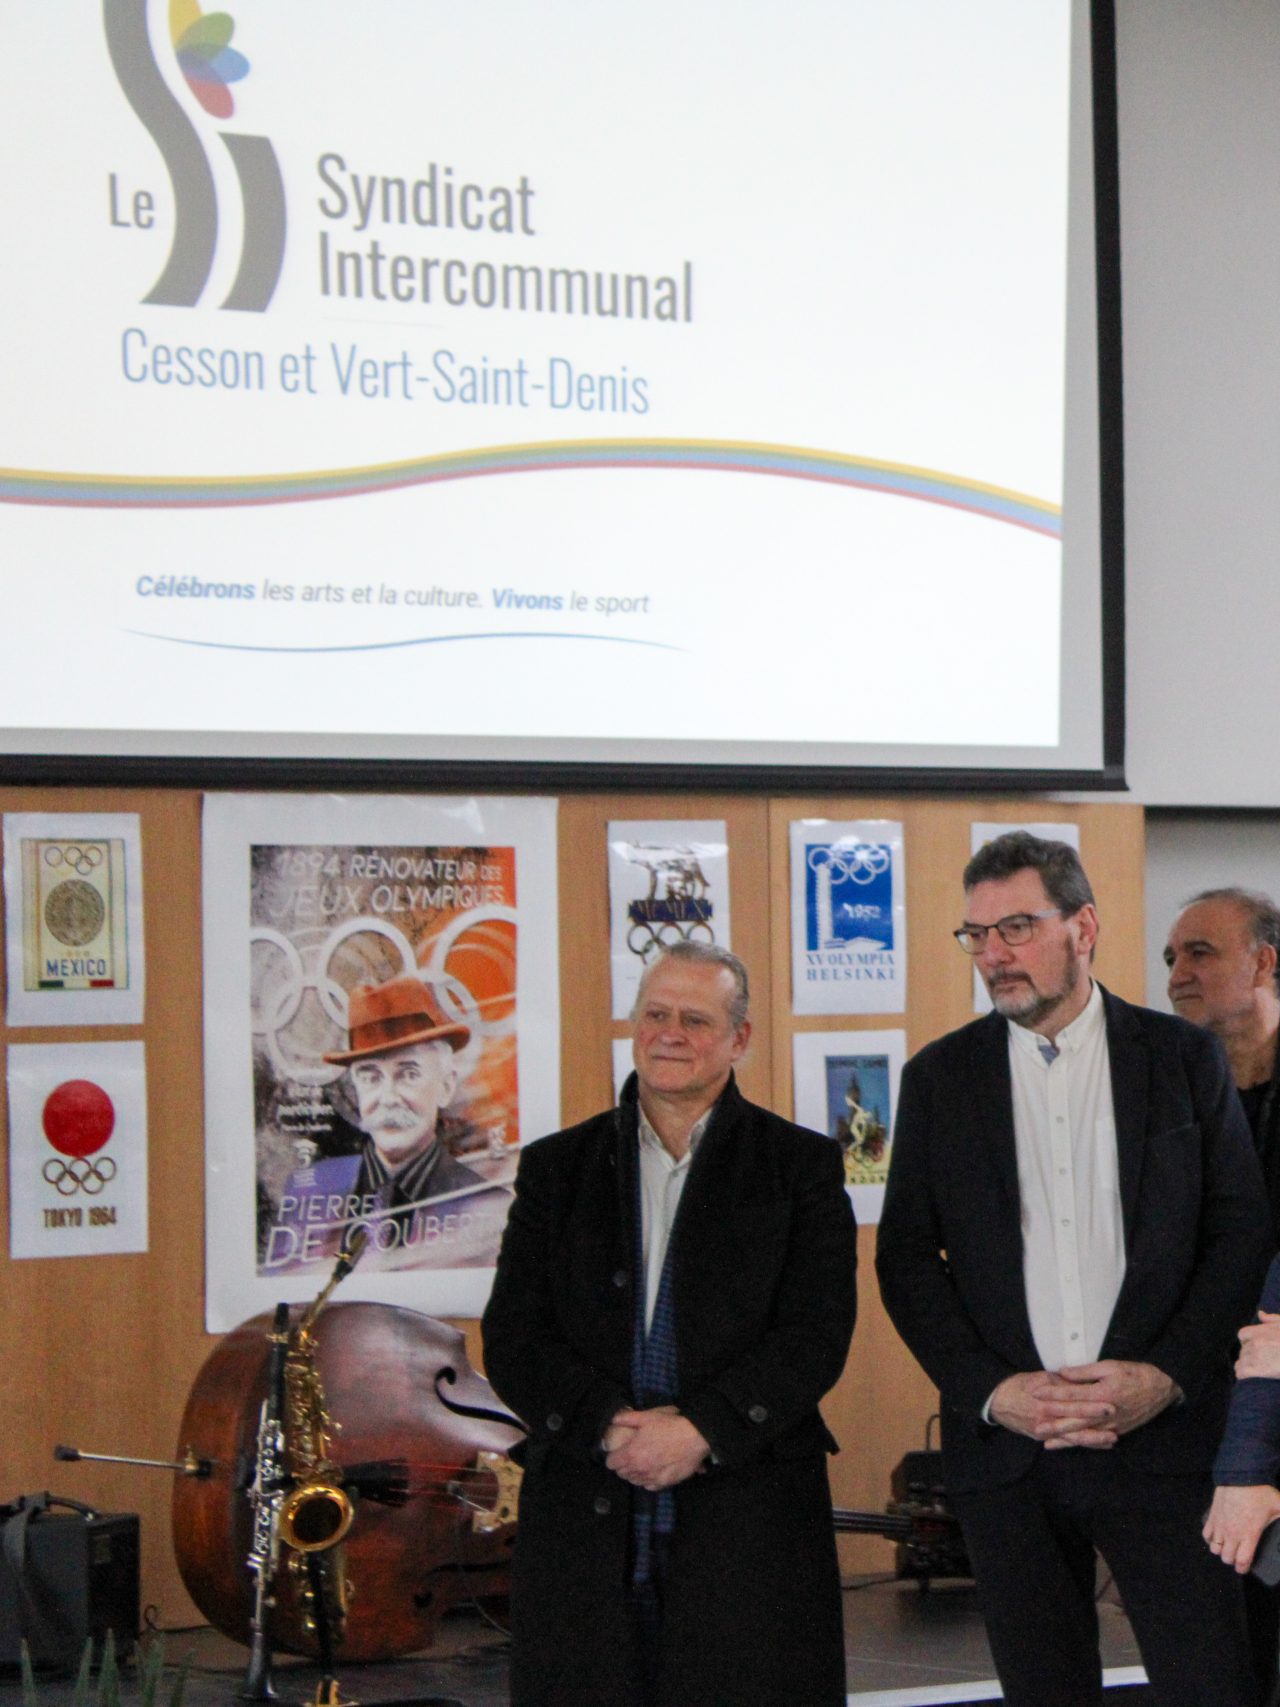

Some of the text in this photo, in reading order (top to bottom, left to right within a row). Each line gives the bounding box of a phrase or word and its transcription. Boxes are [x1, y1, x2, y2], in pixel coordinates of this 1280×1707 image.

[109, 172, 155, 229] Le
[317, 152, 536, 237] Syndicat
[318, 230, 693, 323] Intercommunal
[121, 327, 650, 415] Cesson et Vert-Saint-Denis
[136, 575, 651, 617] Célébrons les arts et la culture. Vivons le sport
[350, 849, 477, 881] RÉNOVATEUR
[268, 883, 505, 917] JEUX OLYMPIQUES
[46, 958, 106, 977] MEXICO
[806, 967, 895, 981] HELSINKI
[827, 952, 895, 966] OLYMPIA
[43, 1206, 82, 1228] TOKYO
[277, 1194, 377, 1222] PIERRE
[264, 1222, 331, 1268] DE
